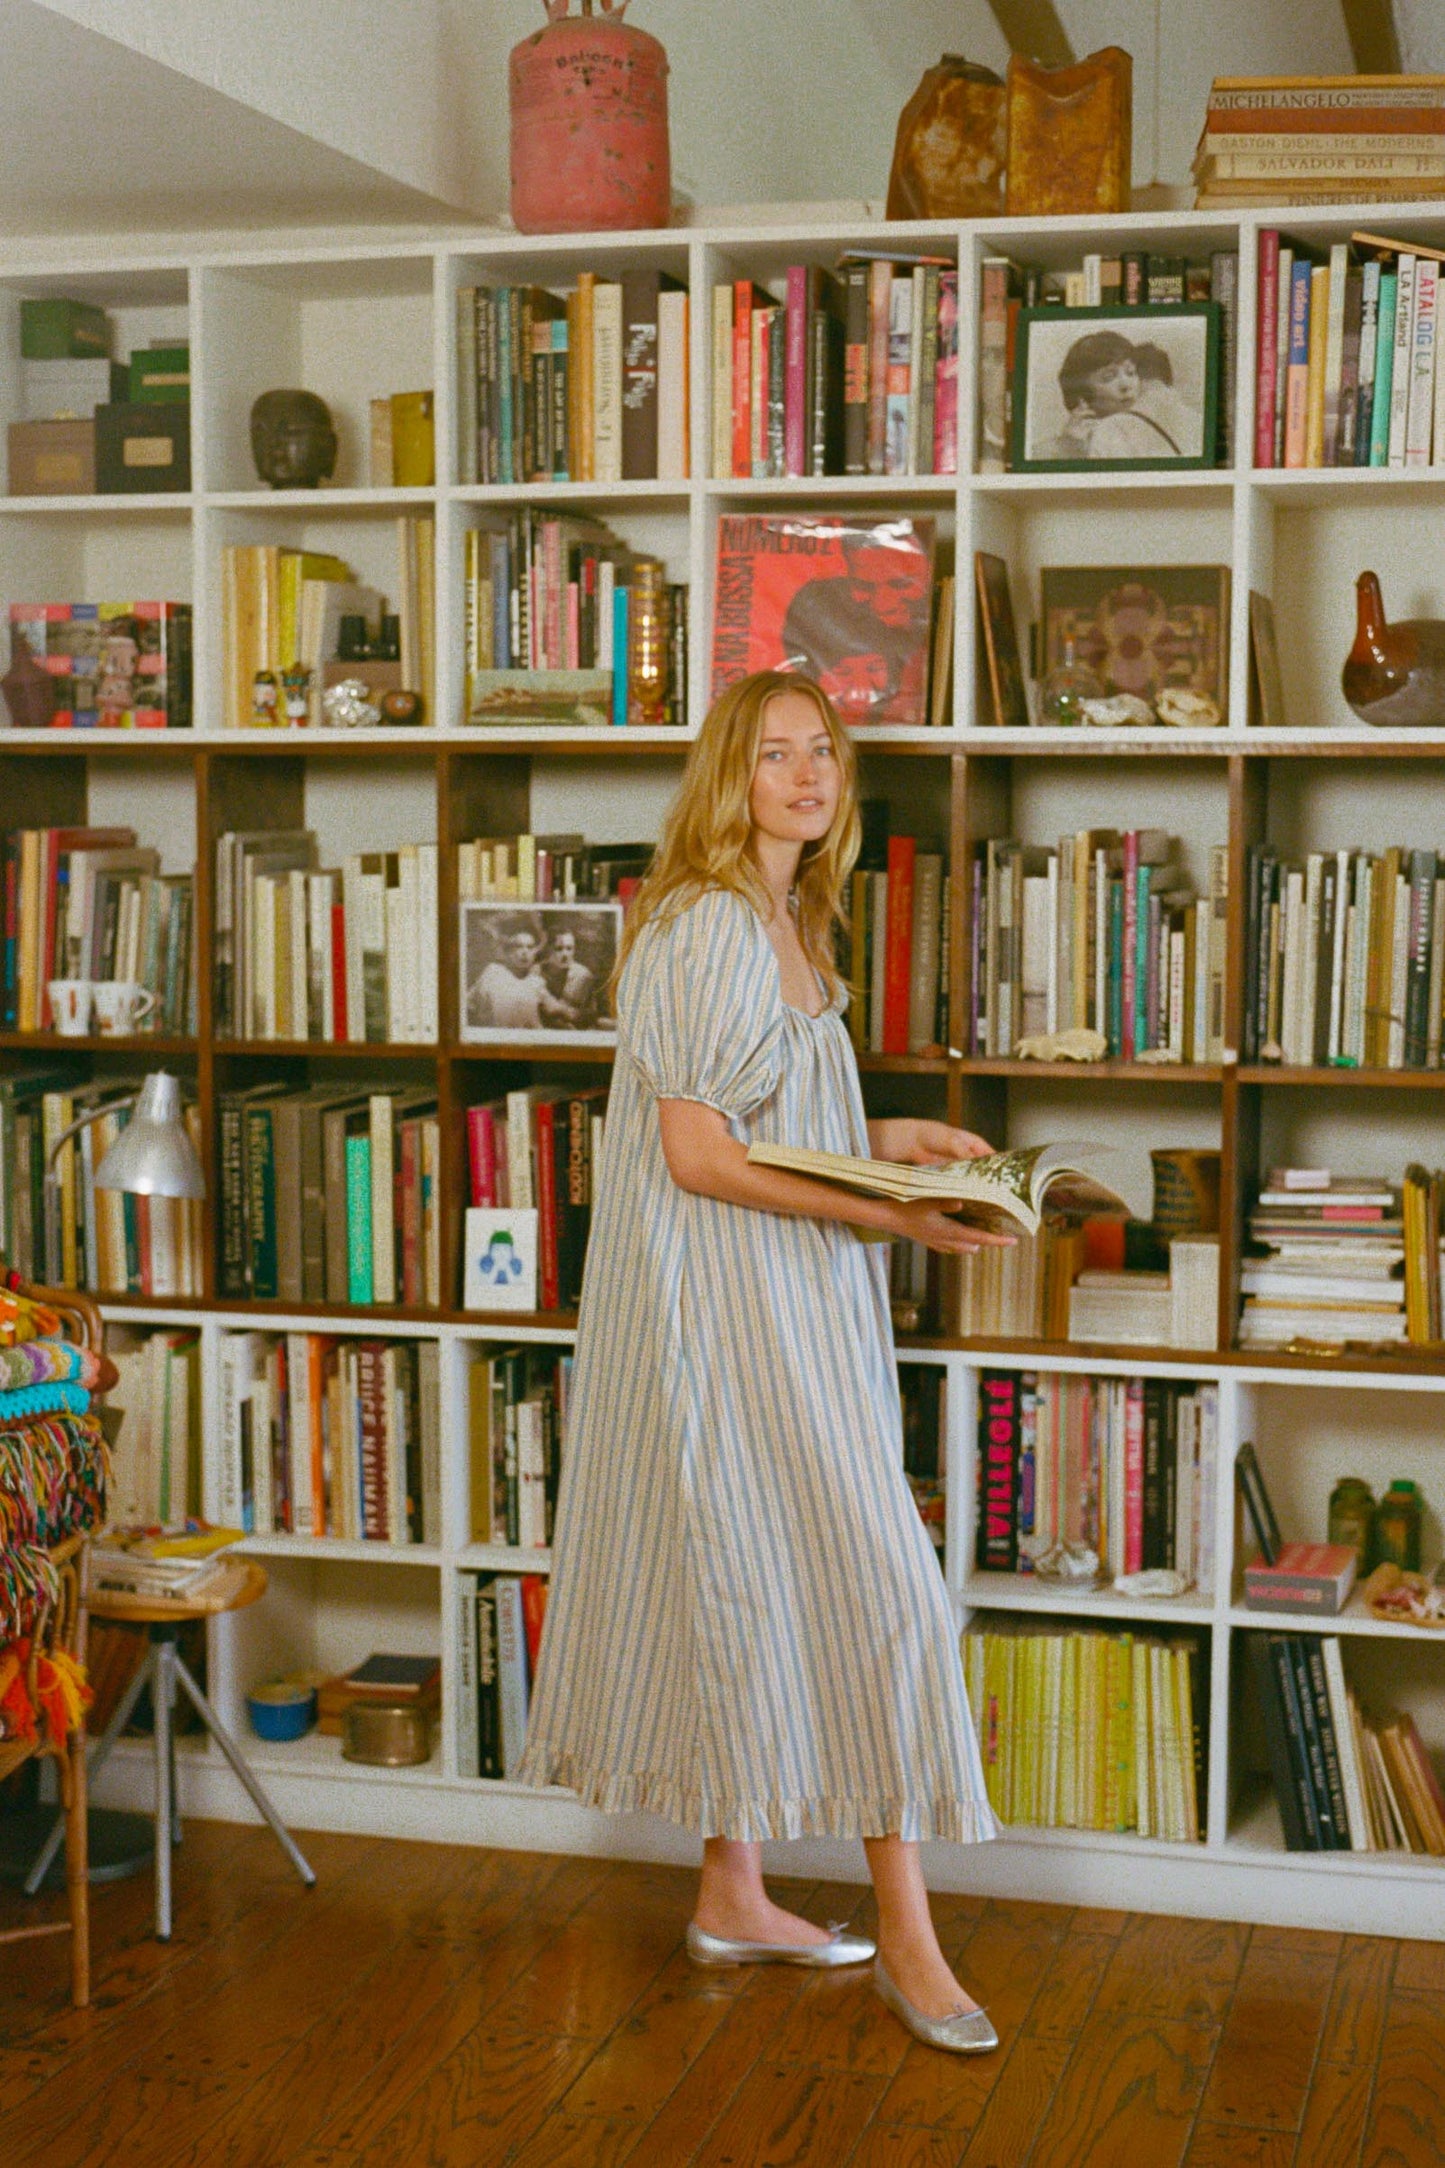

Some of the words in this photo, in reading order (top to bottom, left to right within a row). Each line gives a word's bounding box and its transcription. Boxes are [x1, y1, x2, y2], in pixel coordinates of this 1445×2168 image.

[1213, 93, 1350, 108] MICHELANGELO
[1257, 157, 1346, 171] SALVADOR
[1400, 269, 1412, 289] LA
[1293, 278, 1308, 322] video
[1292, 323, 1305, 349] art
[360, 1352, 377, 1427] BRUCE
[984, 1379, 1015, 1539] VILLEGLÉ
[363, 1435, 380, 1534] NAUMAN
